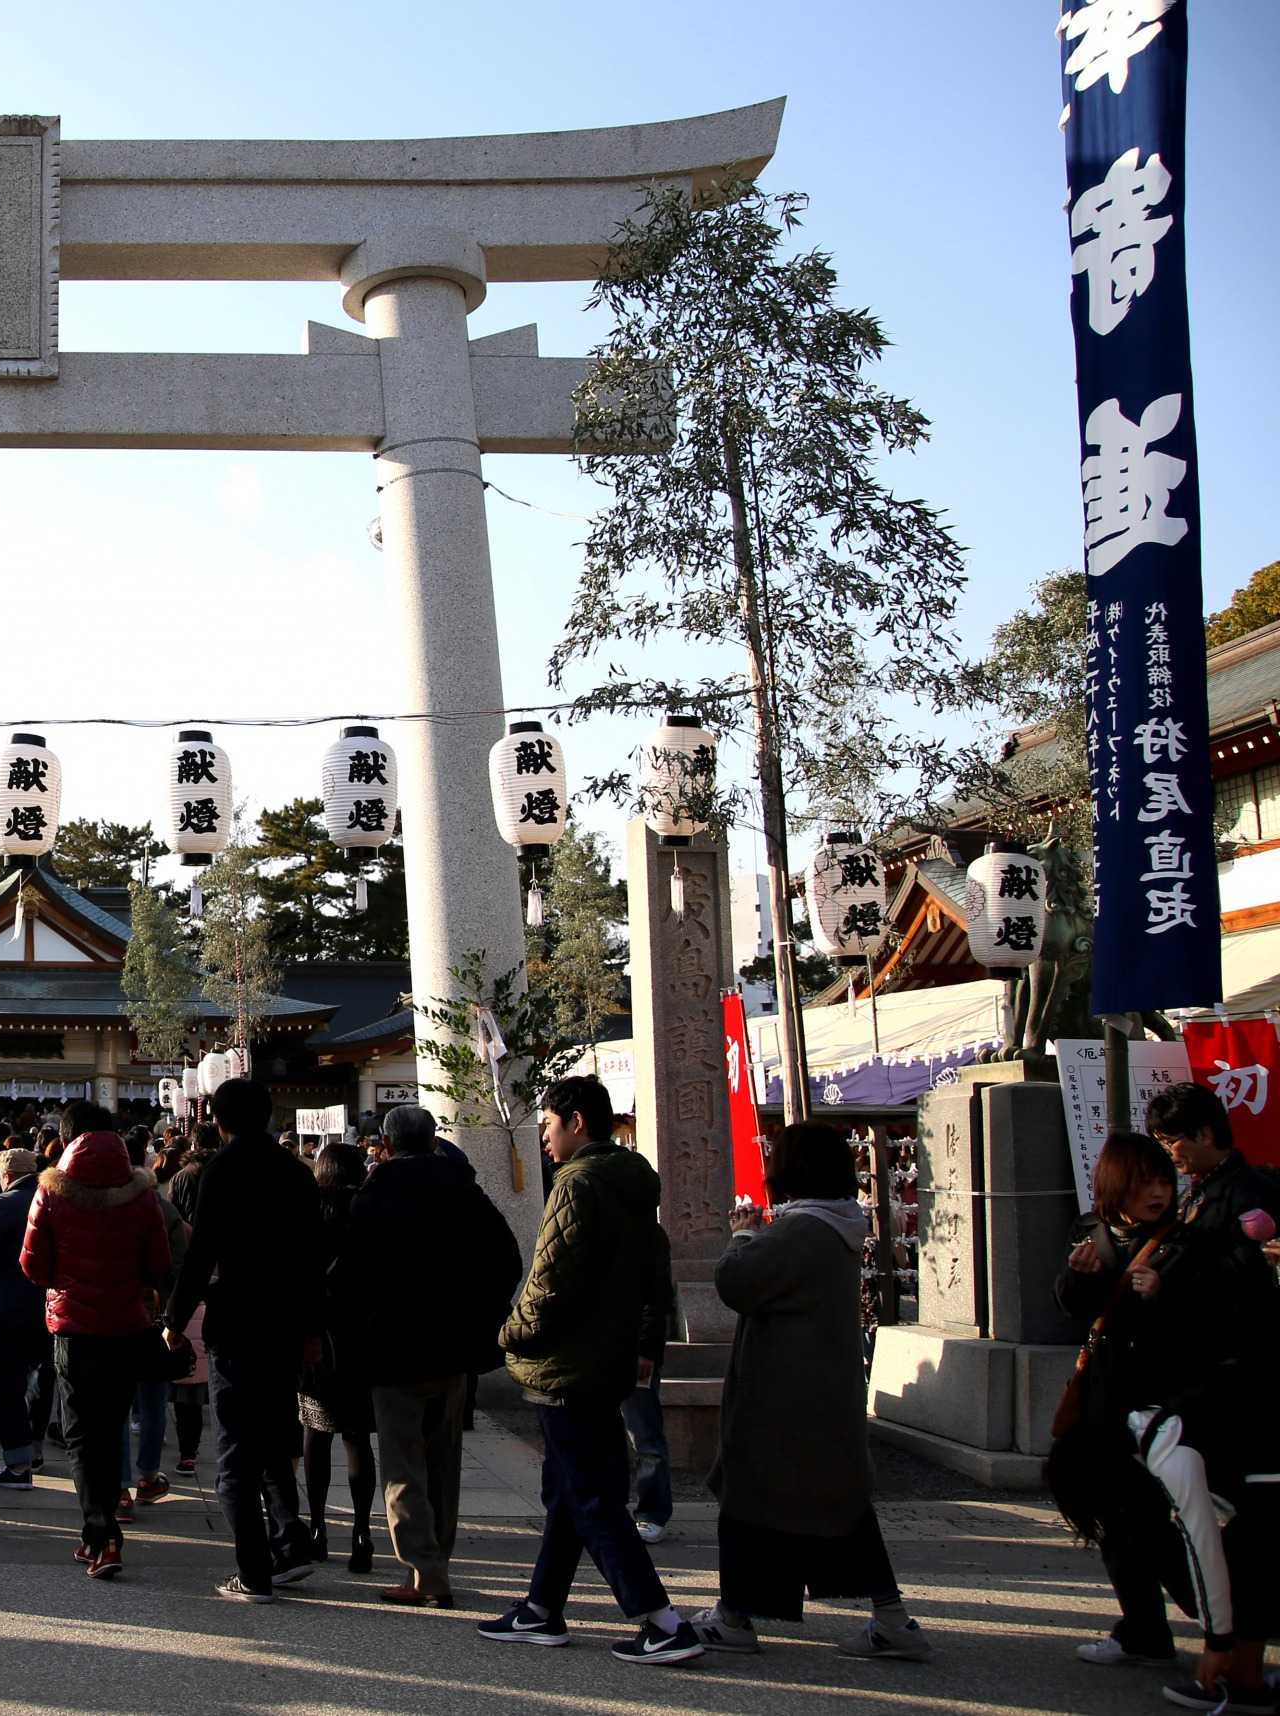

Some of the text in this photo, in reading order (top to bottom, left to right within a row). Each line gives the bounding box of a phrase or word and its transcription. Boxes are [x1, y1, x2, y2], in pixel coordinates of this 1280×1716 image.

[5, 757, 48, 840] 献燈
[177, 749, 221, 834] 献燈
[346, 751, 388, 832] 献燈
[515, 739, 560, 825] 献燈
[994, 864, 1039, 950] 献燈
